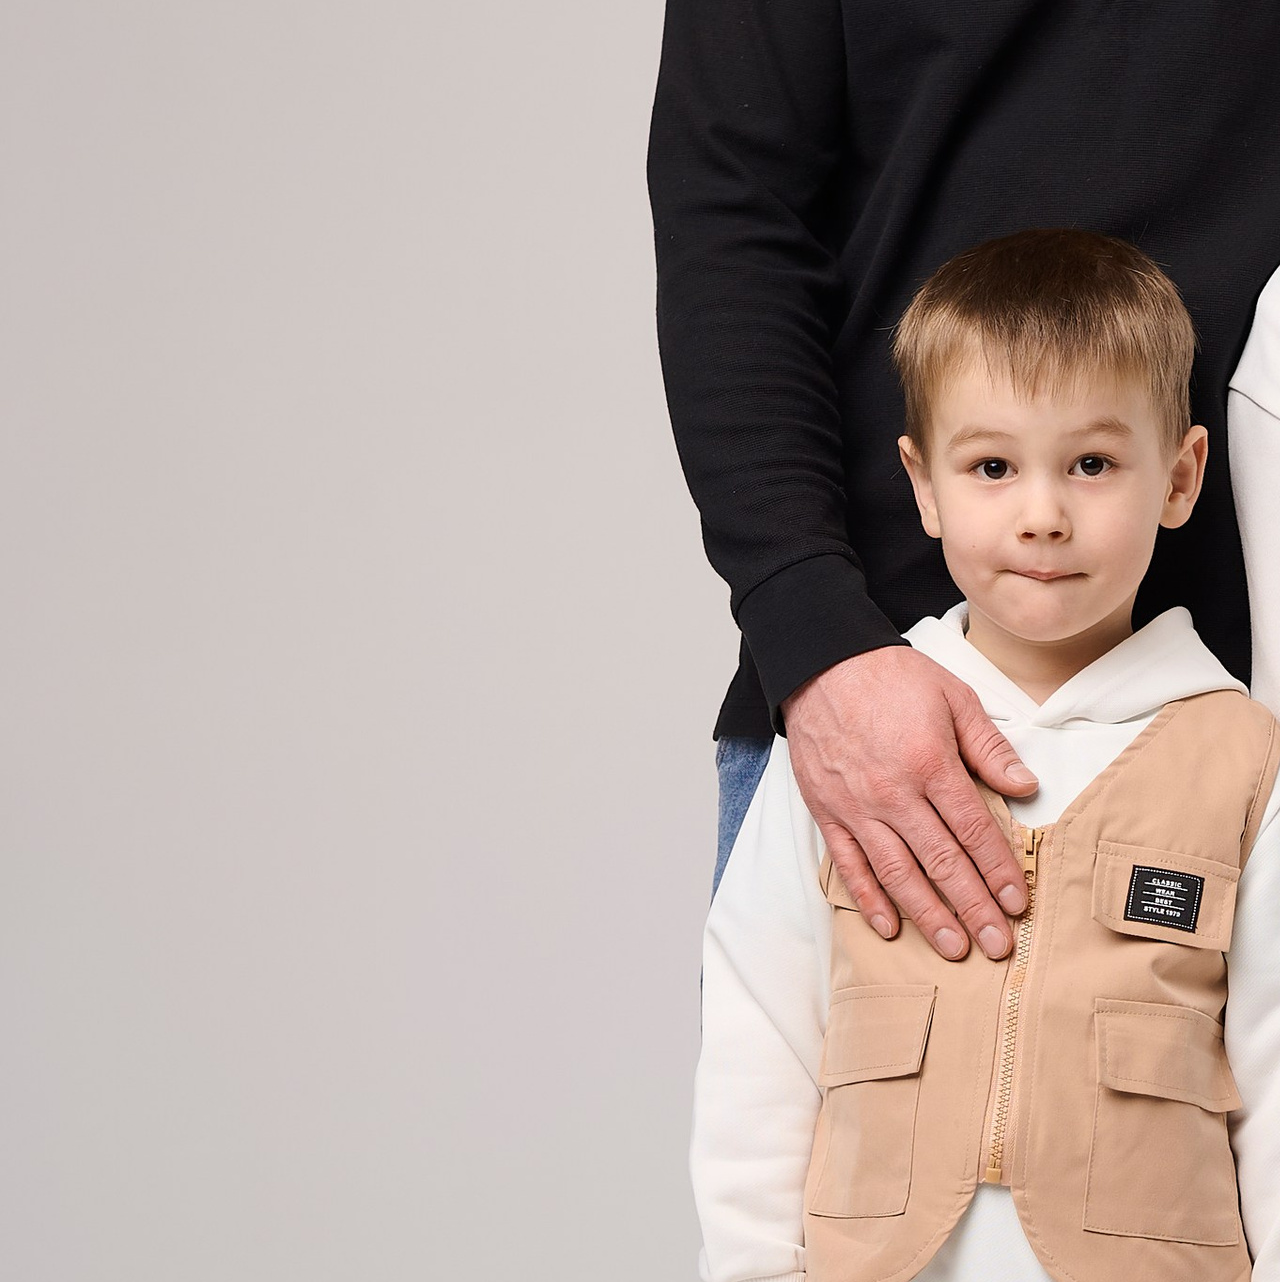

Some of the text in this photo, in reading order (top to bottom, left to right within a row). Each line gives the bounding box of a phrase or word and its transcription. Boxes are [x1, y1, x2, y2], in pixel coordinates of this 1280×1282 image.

[1152, 878, 1182, 888] CLASSIC
[1155, 888, 1175, 897] WEAR
[1154, 897, 1173, 906] BEST
[1143, 906, 1165, 915] STYLE
